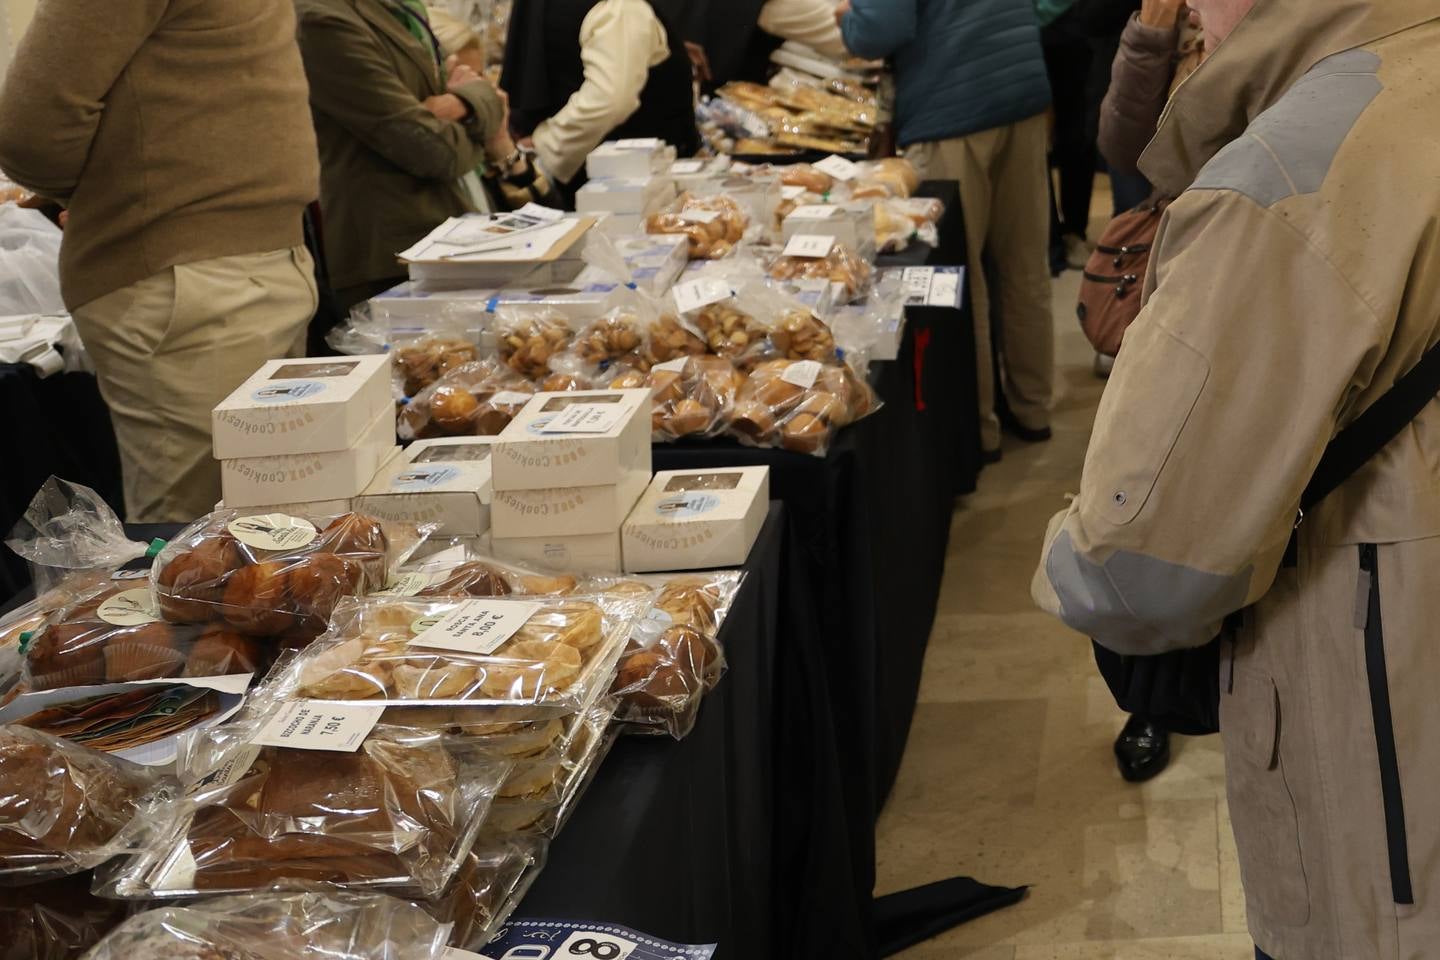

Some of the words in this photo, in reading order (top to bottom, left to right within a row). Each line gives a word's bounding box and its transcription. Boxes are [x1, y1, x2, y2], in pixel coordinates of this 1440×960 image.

[446, 614, 472, 632] ROSCA
[452, 622, 477, 638] SANTA
[473, 610, 490, 624] ANA
[472, 621, 497, 637] 8,00
[492, 613, 504, 621] €
[280, 715, 306, 738] BIZCOCHO
[298, 708, 311, 717] DE
[300, 714, 323, 735] NARANJA
[320, 721, 341, 735] 7,50
